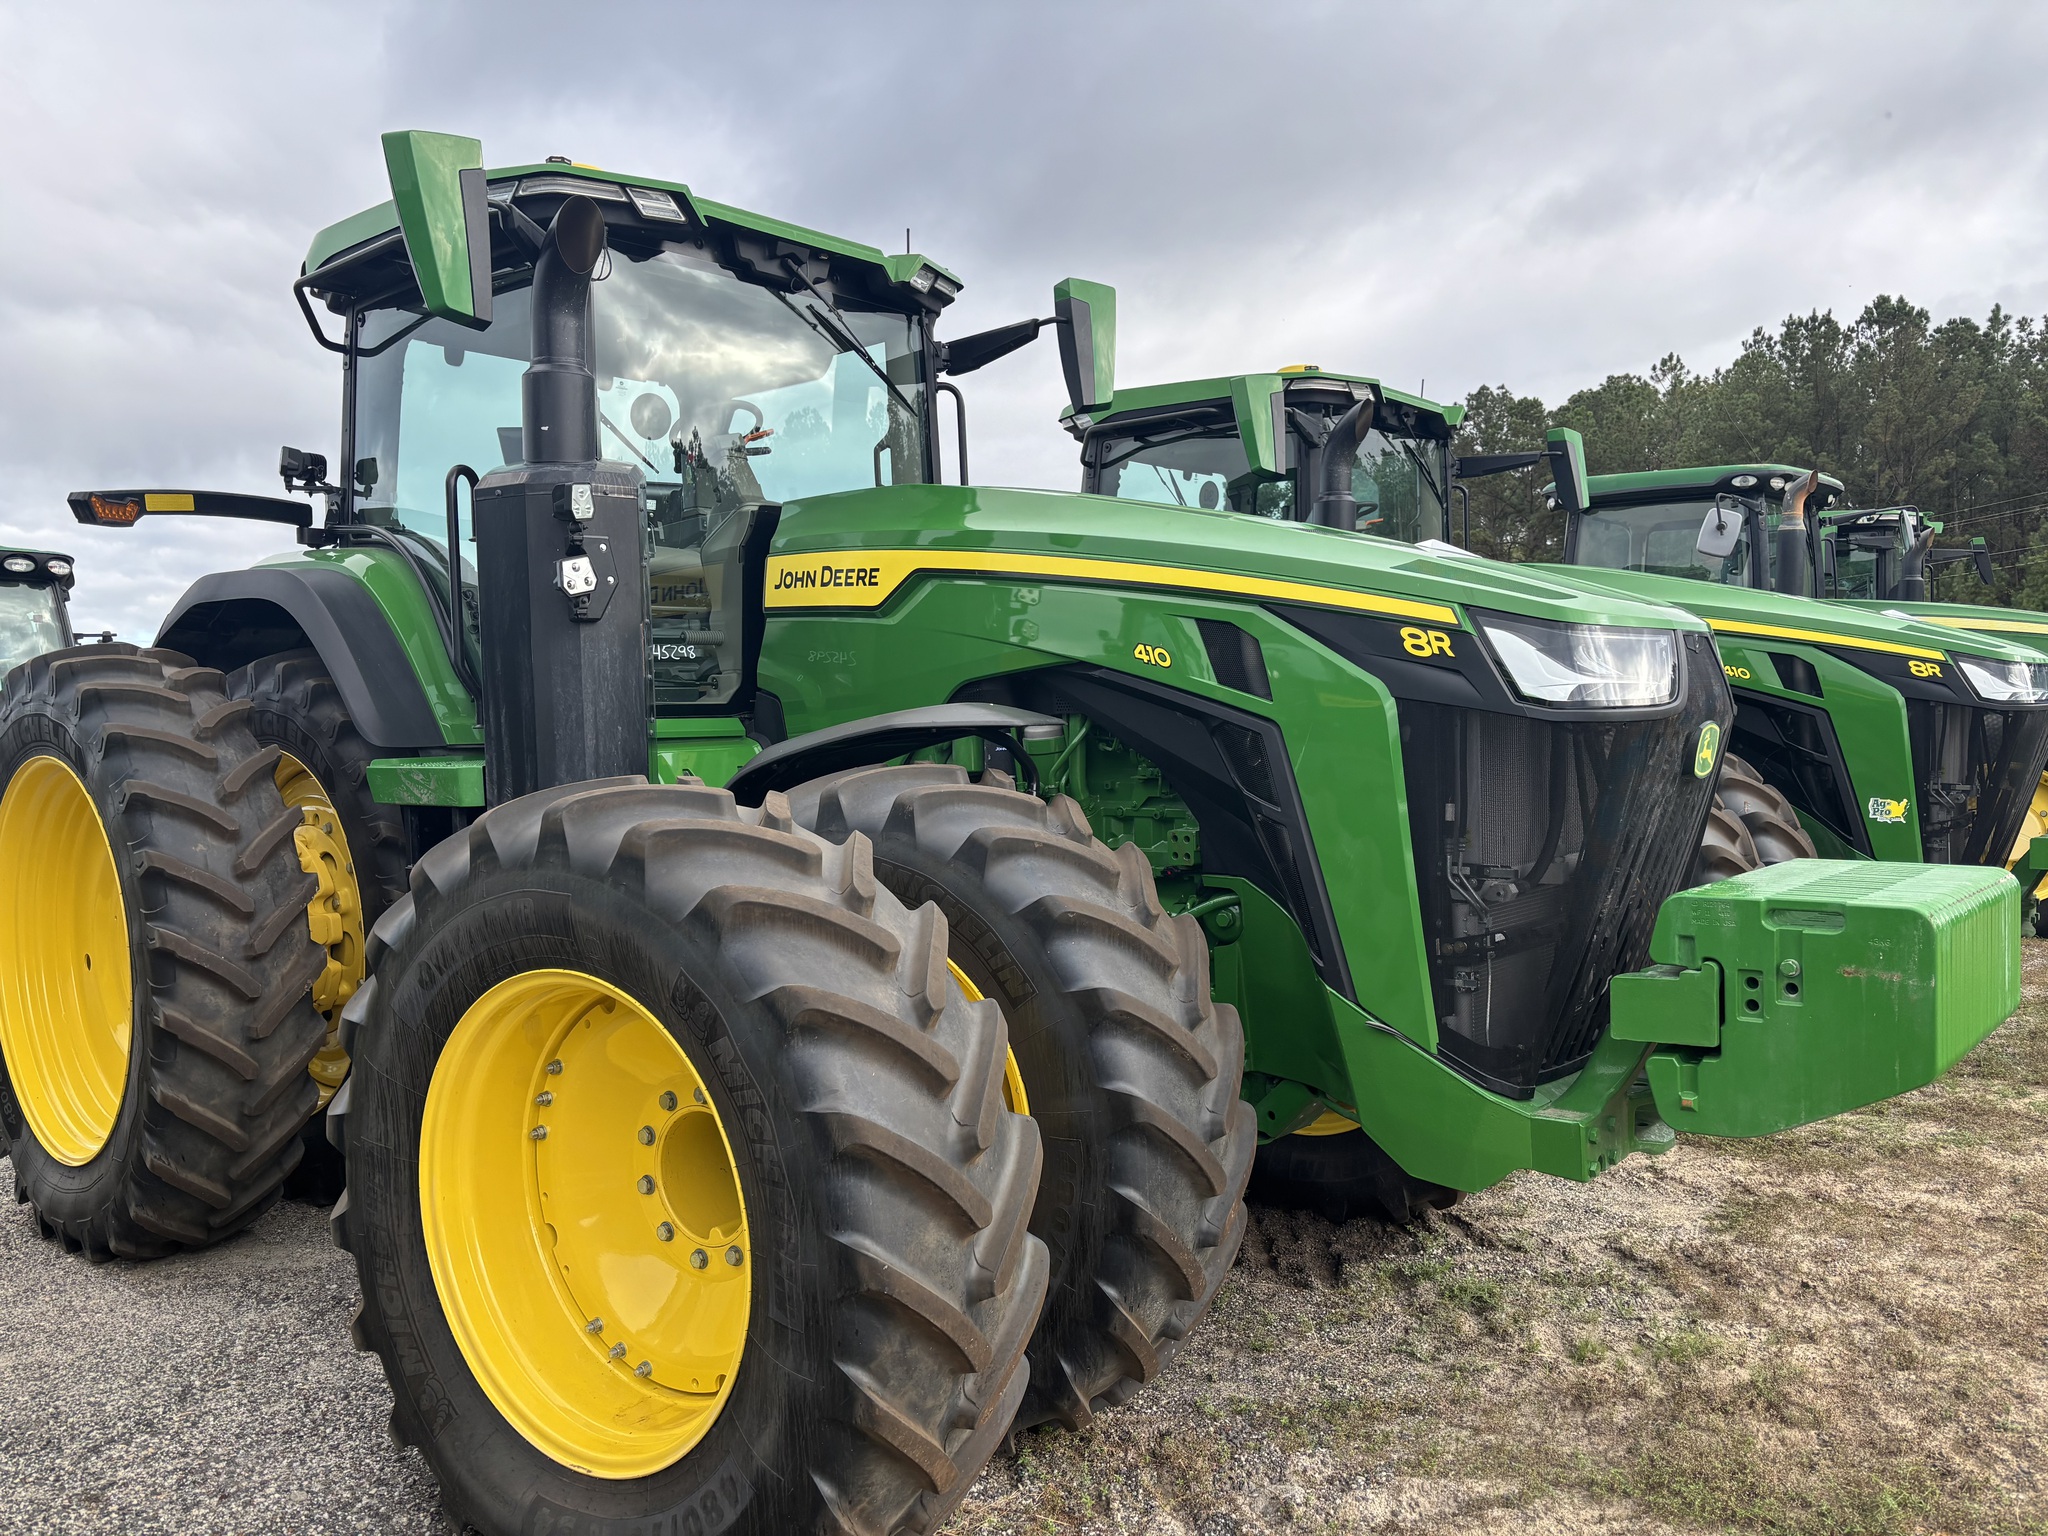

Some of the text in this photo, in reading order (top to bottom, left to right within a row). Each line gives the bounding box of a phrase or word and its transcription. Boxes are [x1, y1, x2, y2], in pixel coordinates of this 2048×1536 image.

[774, 565, 880, 590] JOHN DEERE
[652, 644, 697, 661] 45298
[1399, 626, 1456, 658] 8R
[1133, 643, 1172, 668] 410
[1724, 664, 1751, 680] 410
[1908, 659, 1943, 678] 8R
[1872, 808, 1891, 816] Pro
[878, 862, 1033, 998] MICHELIN
